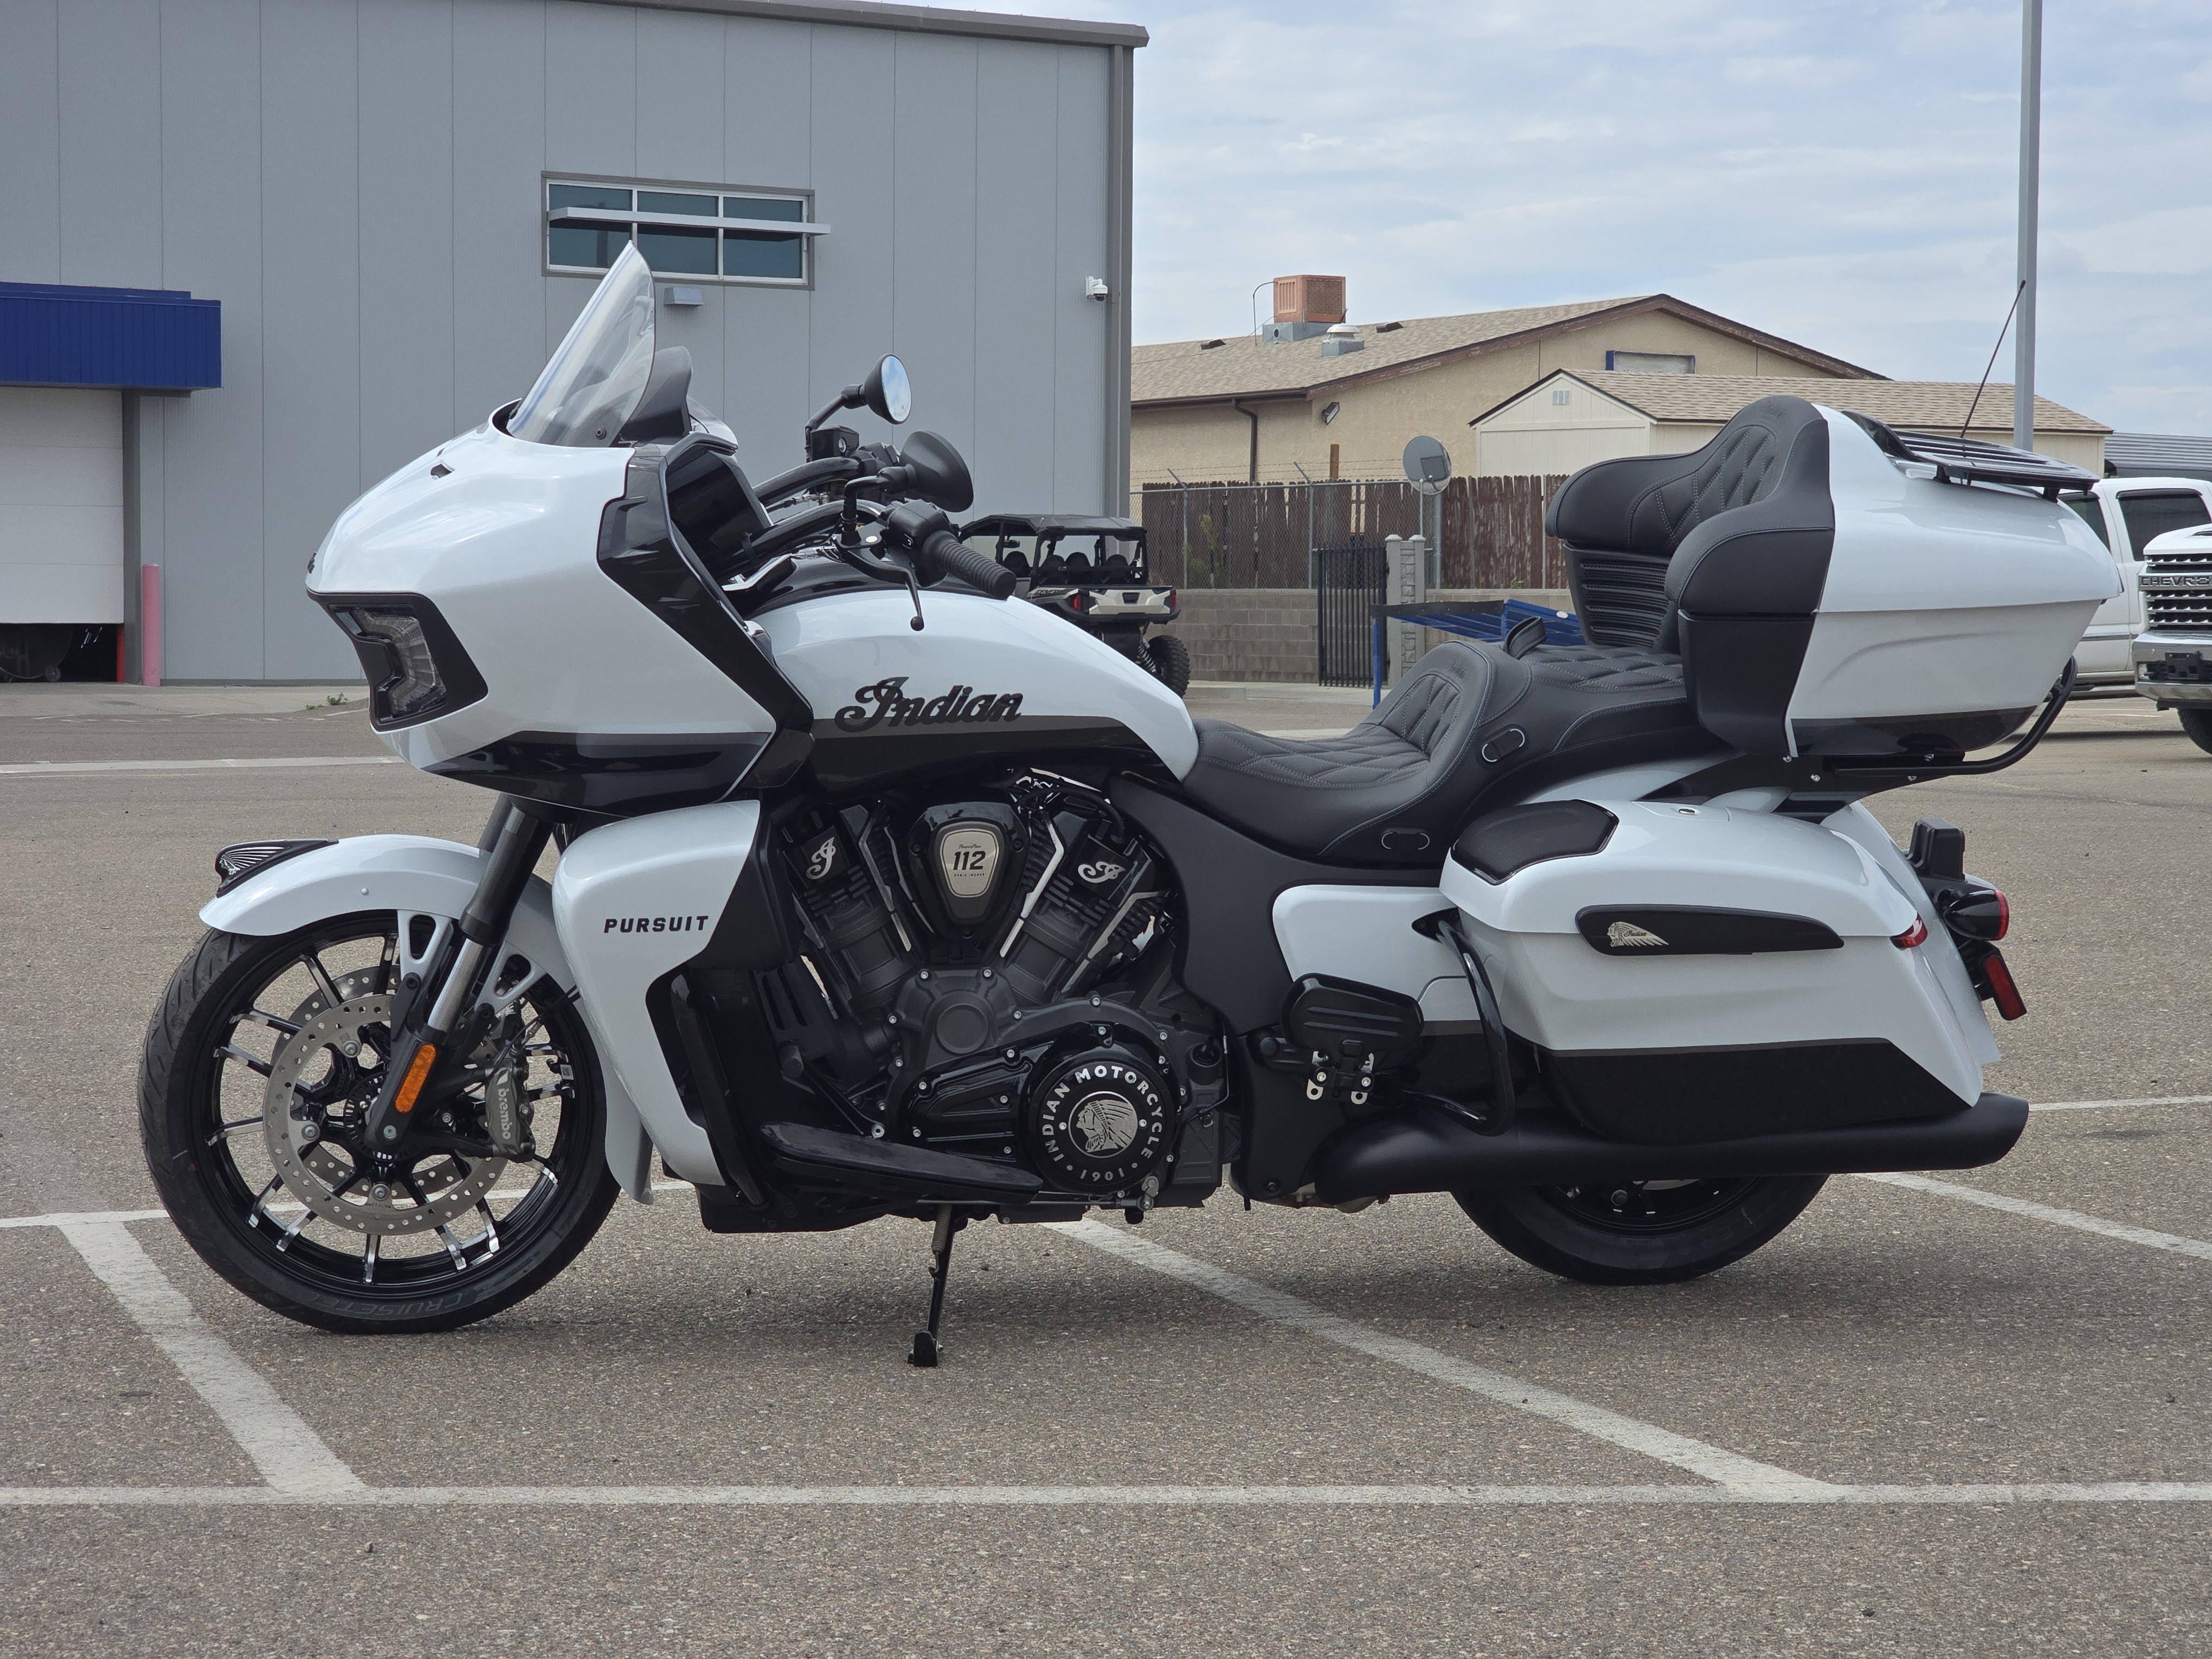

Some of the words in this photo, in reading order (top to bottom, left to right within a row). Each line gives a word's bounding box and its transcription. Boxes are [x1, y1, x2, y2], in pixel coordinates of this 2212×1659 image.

[2141, 576, 2212, 586] CHEVRO
[834, 677, 1023, 732] Indian
[953, 851, 986, 870] 112
[604, 916, 708, 933] PURSUIT
[497, 1088, 513, 1139] brembo
[1042, 1083, 1070, 1161] INDIAN
[1075, 1065, 1162, 1158] MOTORCYCLE
[1081, 1168, 1124, 1181] 1901
